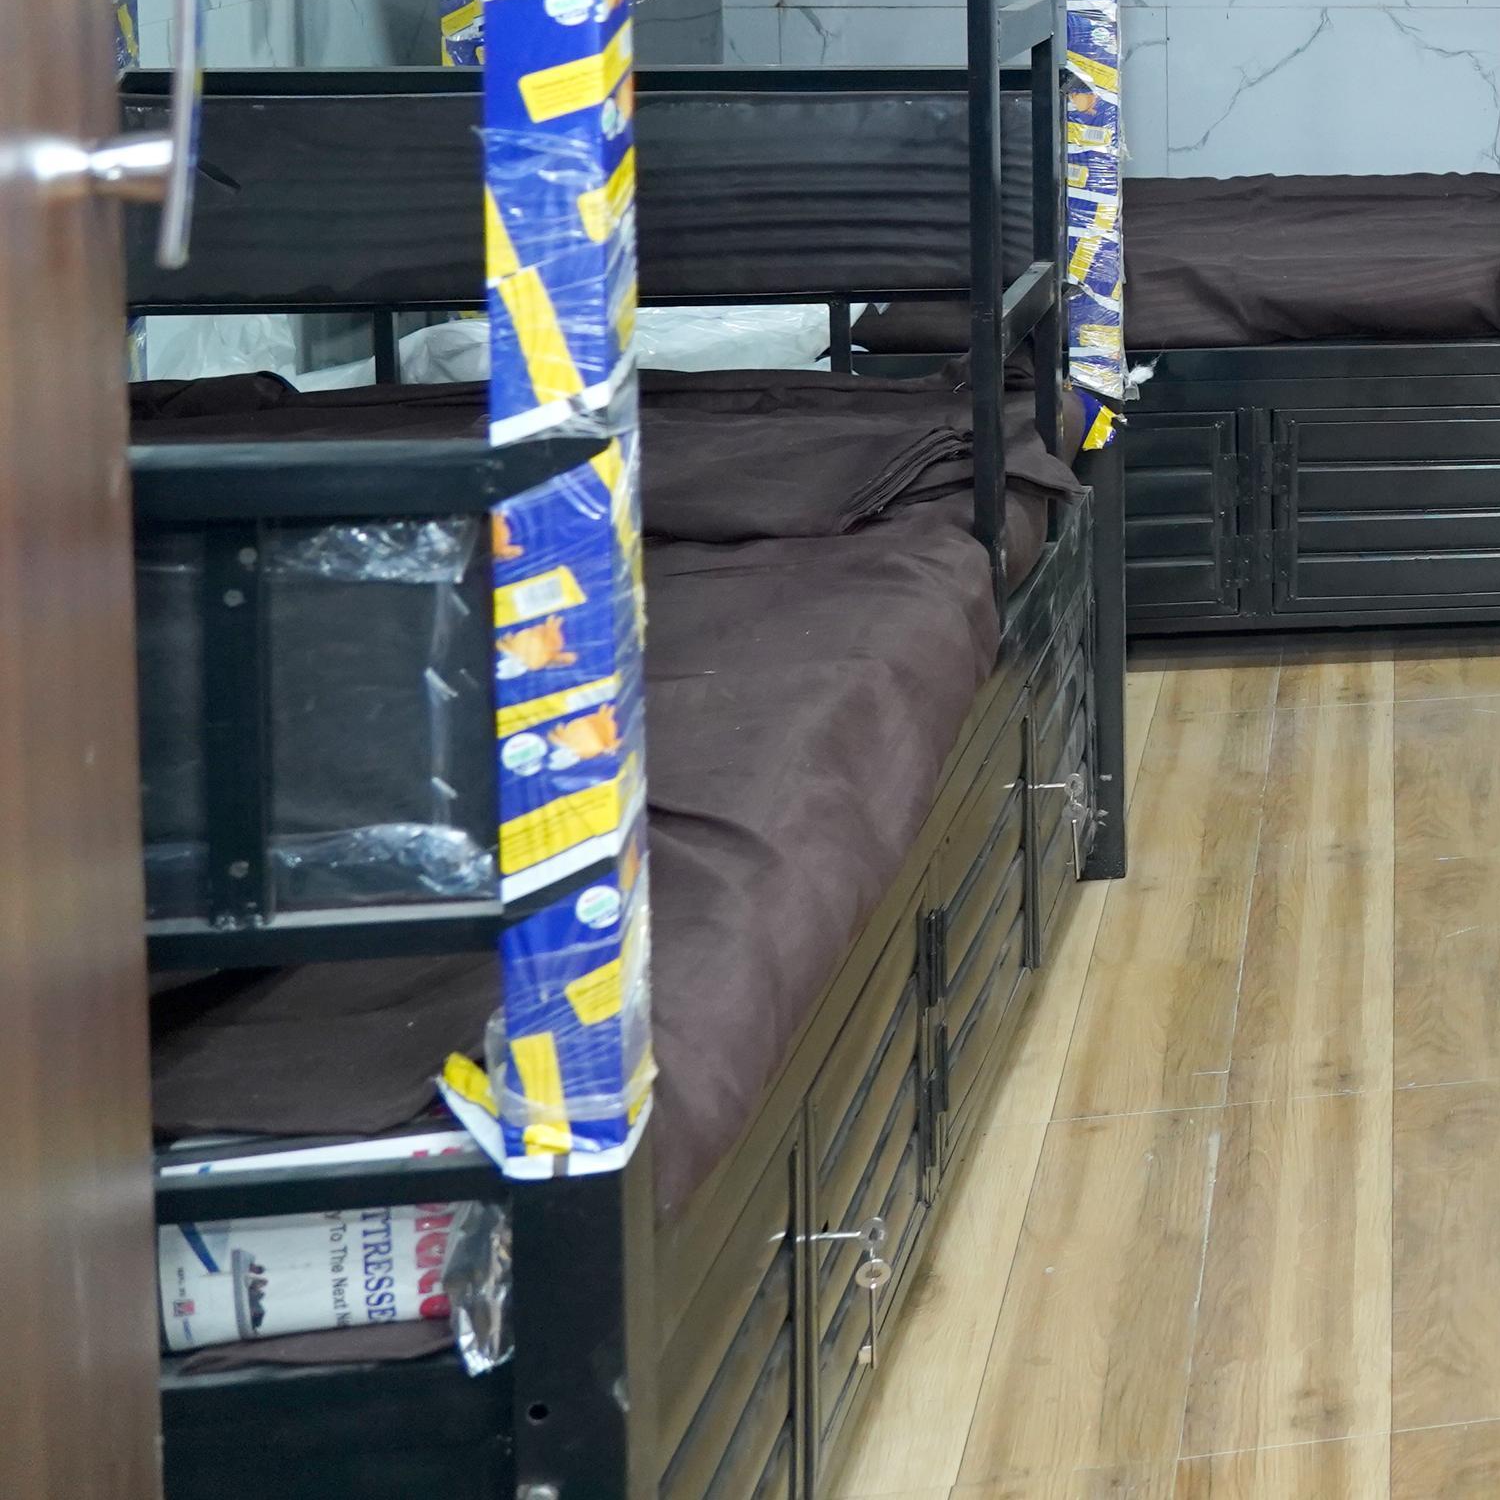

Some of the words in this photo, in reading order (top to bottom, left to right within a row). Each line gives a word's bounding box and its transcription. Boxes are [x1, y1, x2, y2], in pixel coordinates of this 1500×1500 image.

[330, 1246, 348, 1274] The
[361, 1206, 397, 1324] TTRESSE
[331, 1277, 349, 1310] Next
